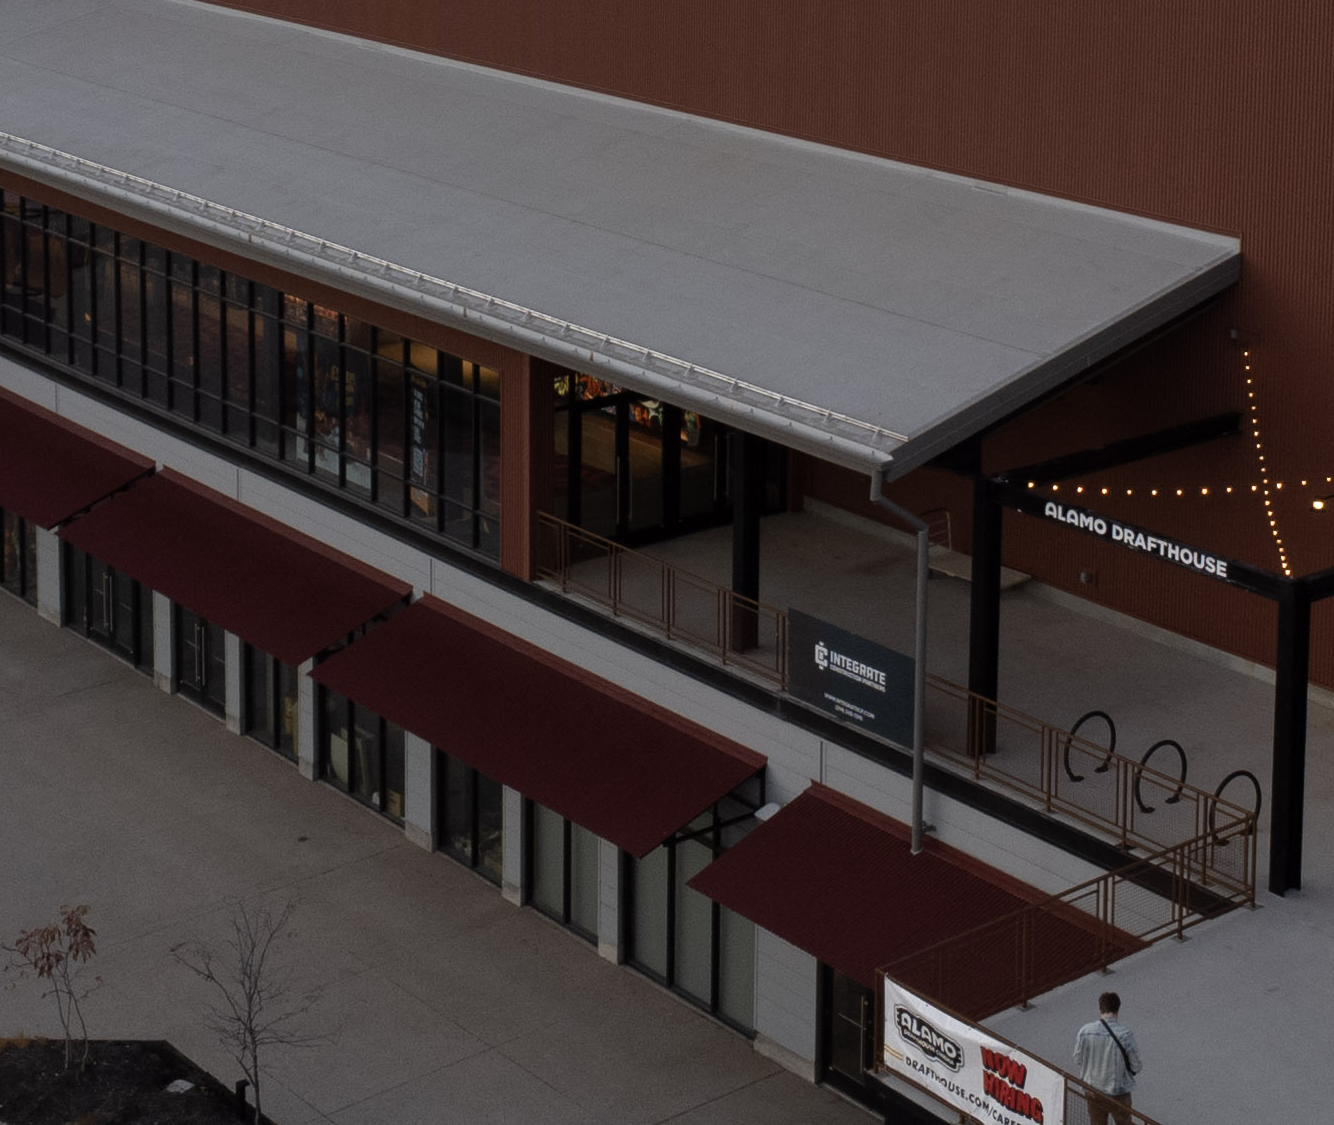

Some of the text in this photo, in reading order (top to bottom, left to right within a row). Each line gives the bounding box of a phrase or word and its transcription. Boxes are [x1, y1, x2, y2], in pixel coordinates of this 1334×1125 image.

[1045, 501, 1228, 578] ALAMO DRAFTHOUSE
[830, 650, 886, 685] INTEGRATE
[900, 1012, 957, 1059] ALAMO
[980, 1045, 1028, 1090] NOW
[982, 1068, 1044, 1125] HIRING
